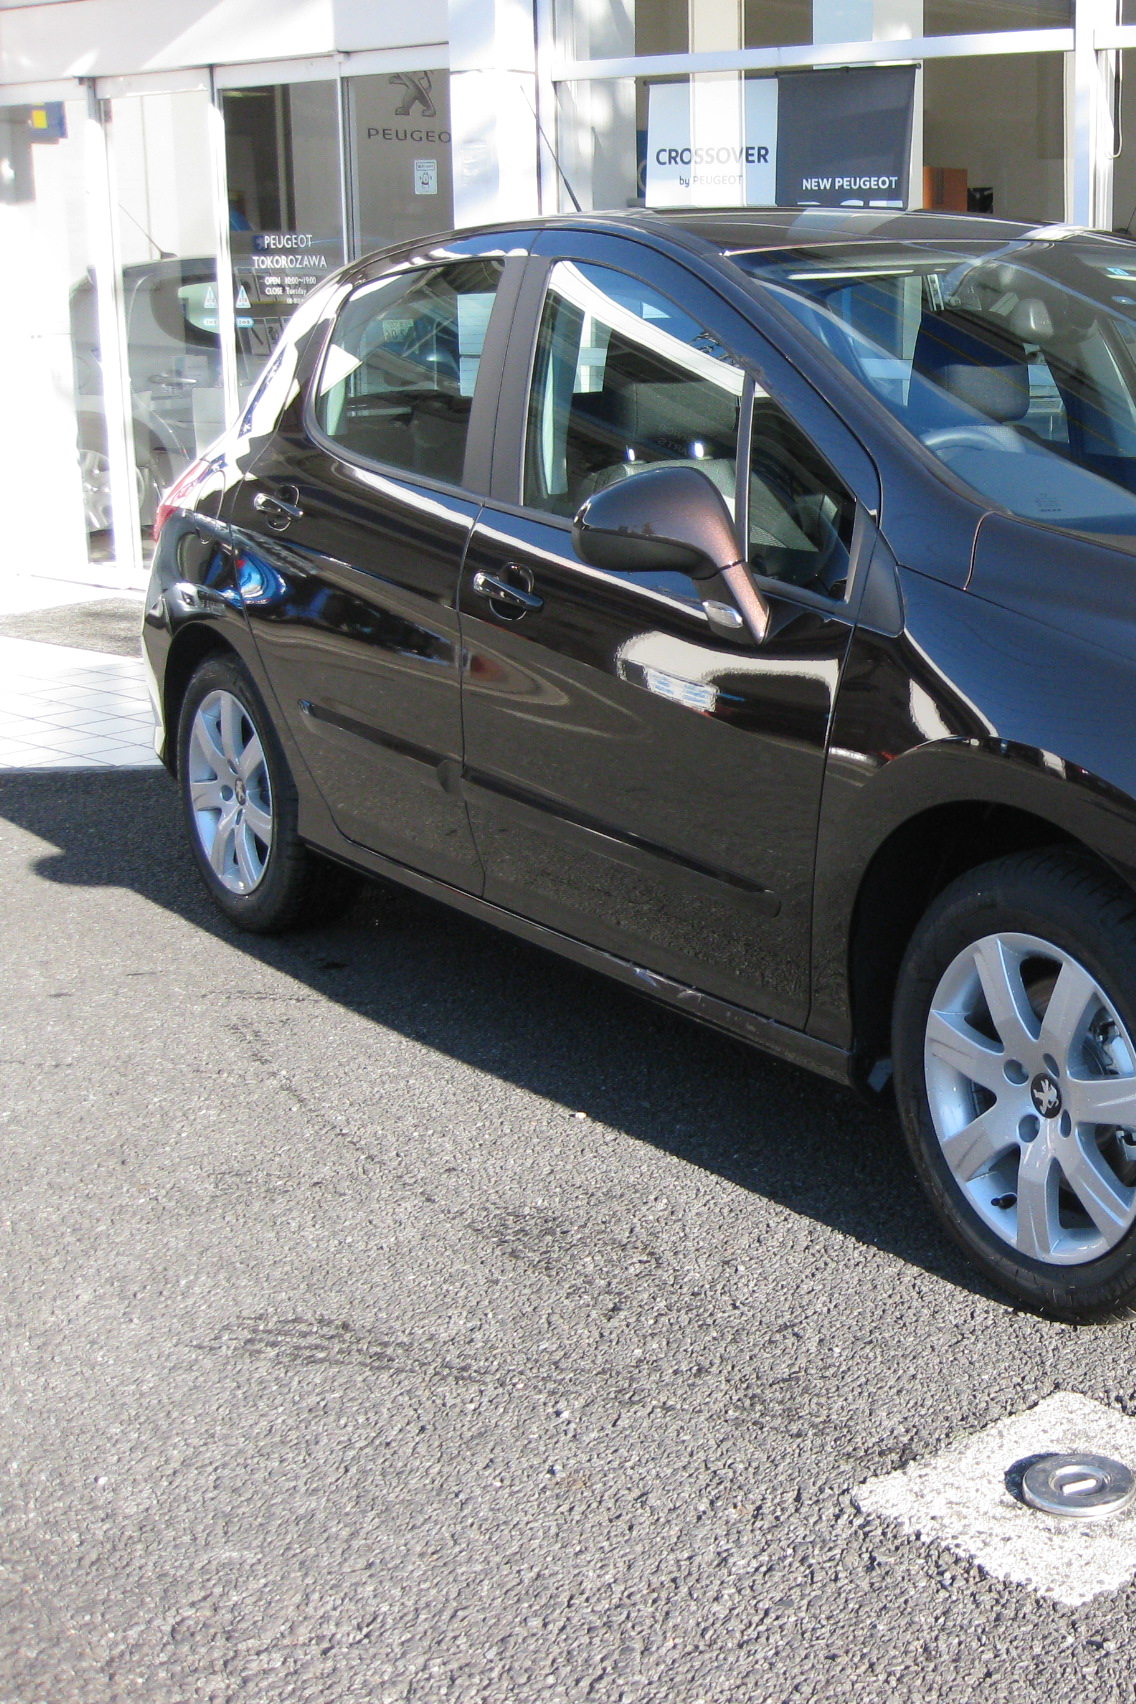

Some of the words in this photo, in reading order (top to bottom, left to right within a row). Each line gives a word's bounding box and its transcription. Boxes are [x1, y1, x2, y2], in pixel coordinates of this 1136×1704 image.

[367, 128, 451, 143] PEUGEO
[656, 146, 769, 166] CROSSOVER
[679, 175, 690, 188] by
[693, 175, 743, 186] PEUGEOT
[802, 178, 832, 190] NEW
[835, 176, 898, 190] PEUGEOT
[264, 234, 313, 249] PEUGEOT
[252, 255, 328, 269] TOKOROZAWA
[265, 277, 281, 285] OPEN
[265, 287, 283, 295] CLOSE
